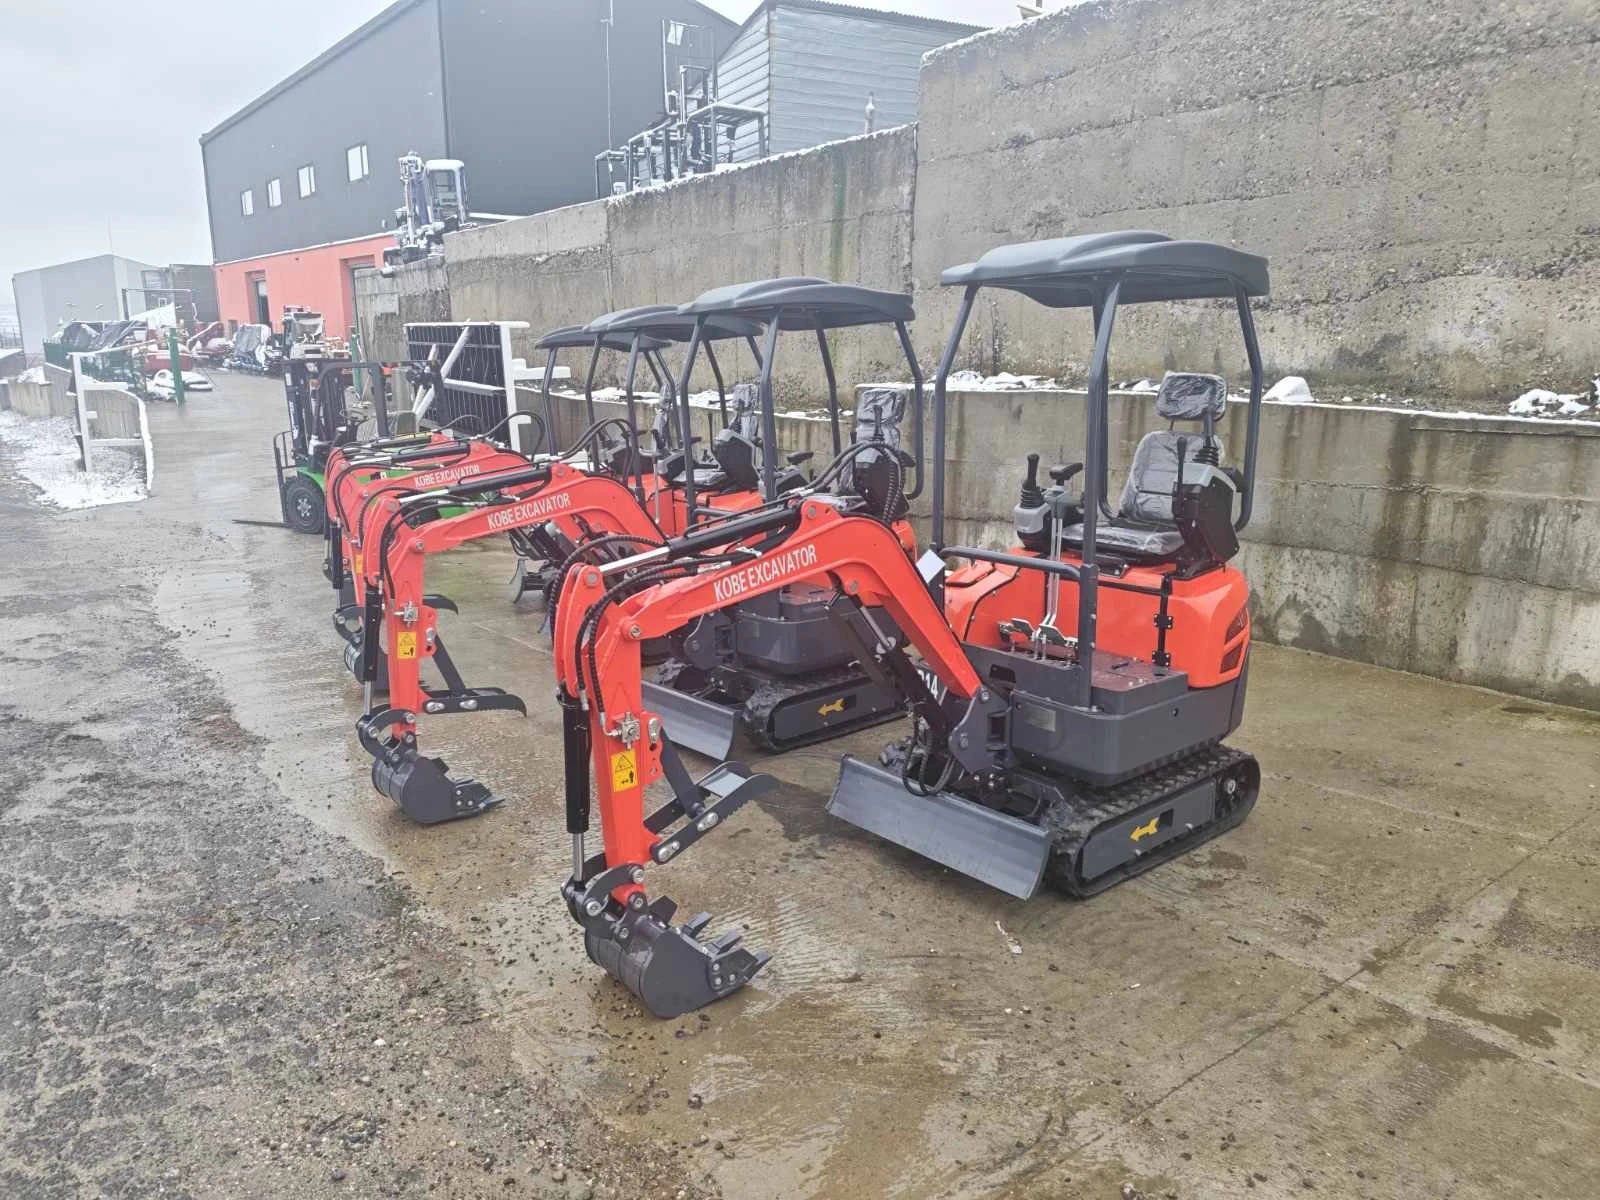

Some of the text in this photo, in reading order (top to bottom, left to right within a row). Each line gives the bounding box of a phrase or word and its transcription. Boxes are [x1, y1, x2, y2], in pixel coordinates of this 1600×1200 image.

[415, 463, 480, 489] KOBE EXCAVATOR
[487, 493, 571, 529] KOBE EXCAVATOR
[713, 544, 817, 602] KOBE EXCAVATOR
